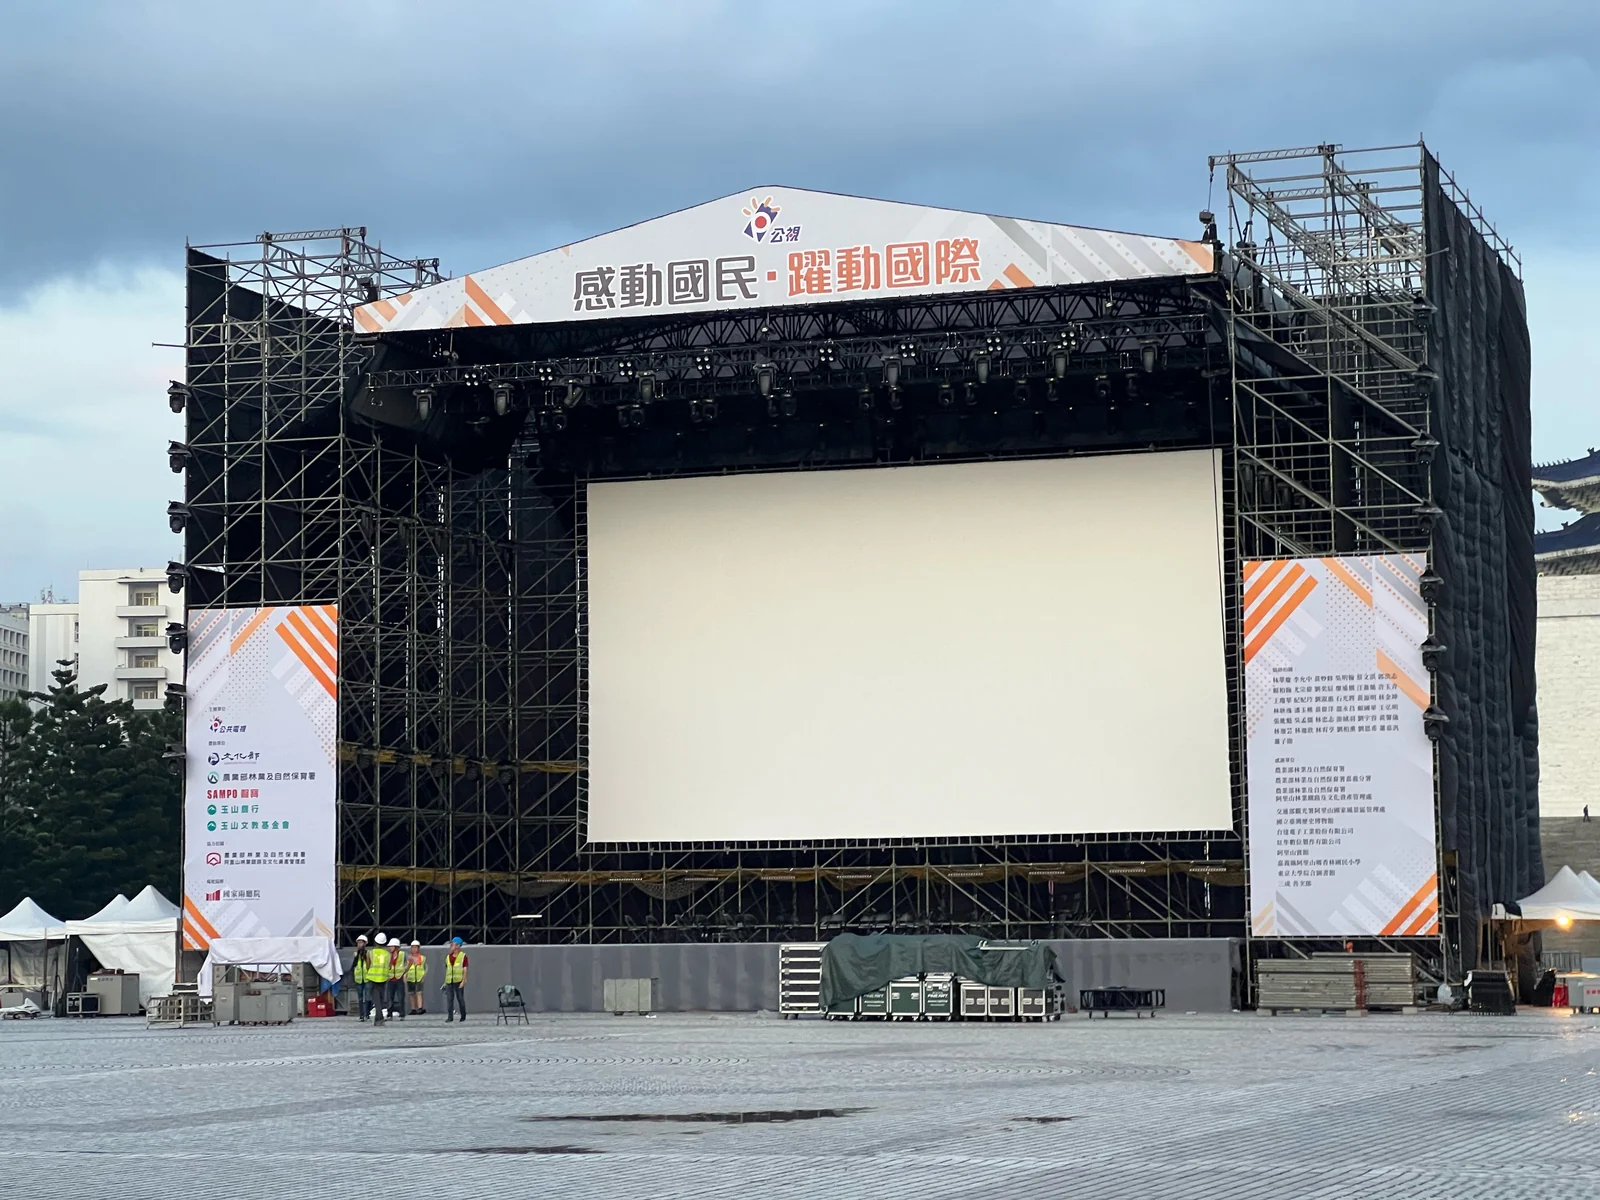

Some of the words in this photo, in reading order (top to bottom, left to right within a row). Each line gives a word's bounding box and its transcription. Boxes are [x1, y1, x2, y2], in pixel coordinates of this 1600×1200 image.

[770, 226, 801, 243] 公視
[220, 725, 247, 734] 公共電視
[221, 751, 260, 761] 文化部
[222, 772, 316, 781] 農業部林業及自然保育署
[207, 789, 238, 799] SAMPO
[220, 821, 289, 830] 玉山文教基金會
[222, 889, 261, 898] 國家兩廳院
